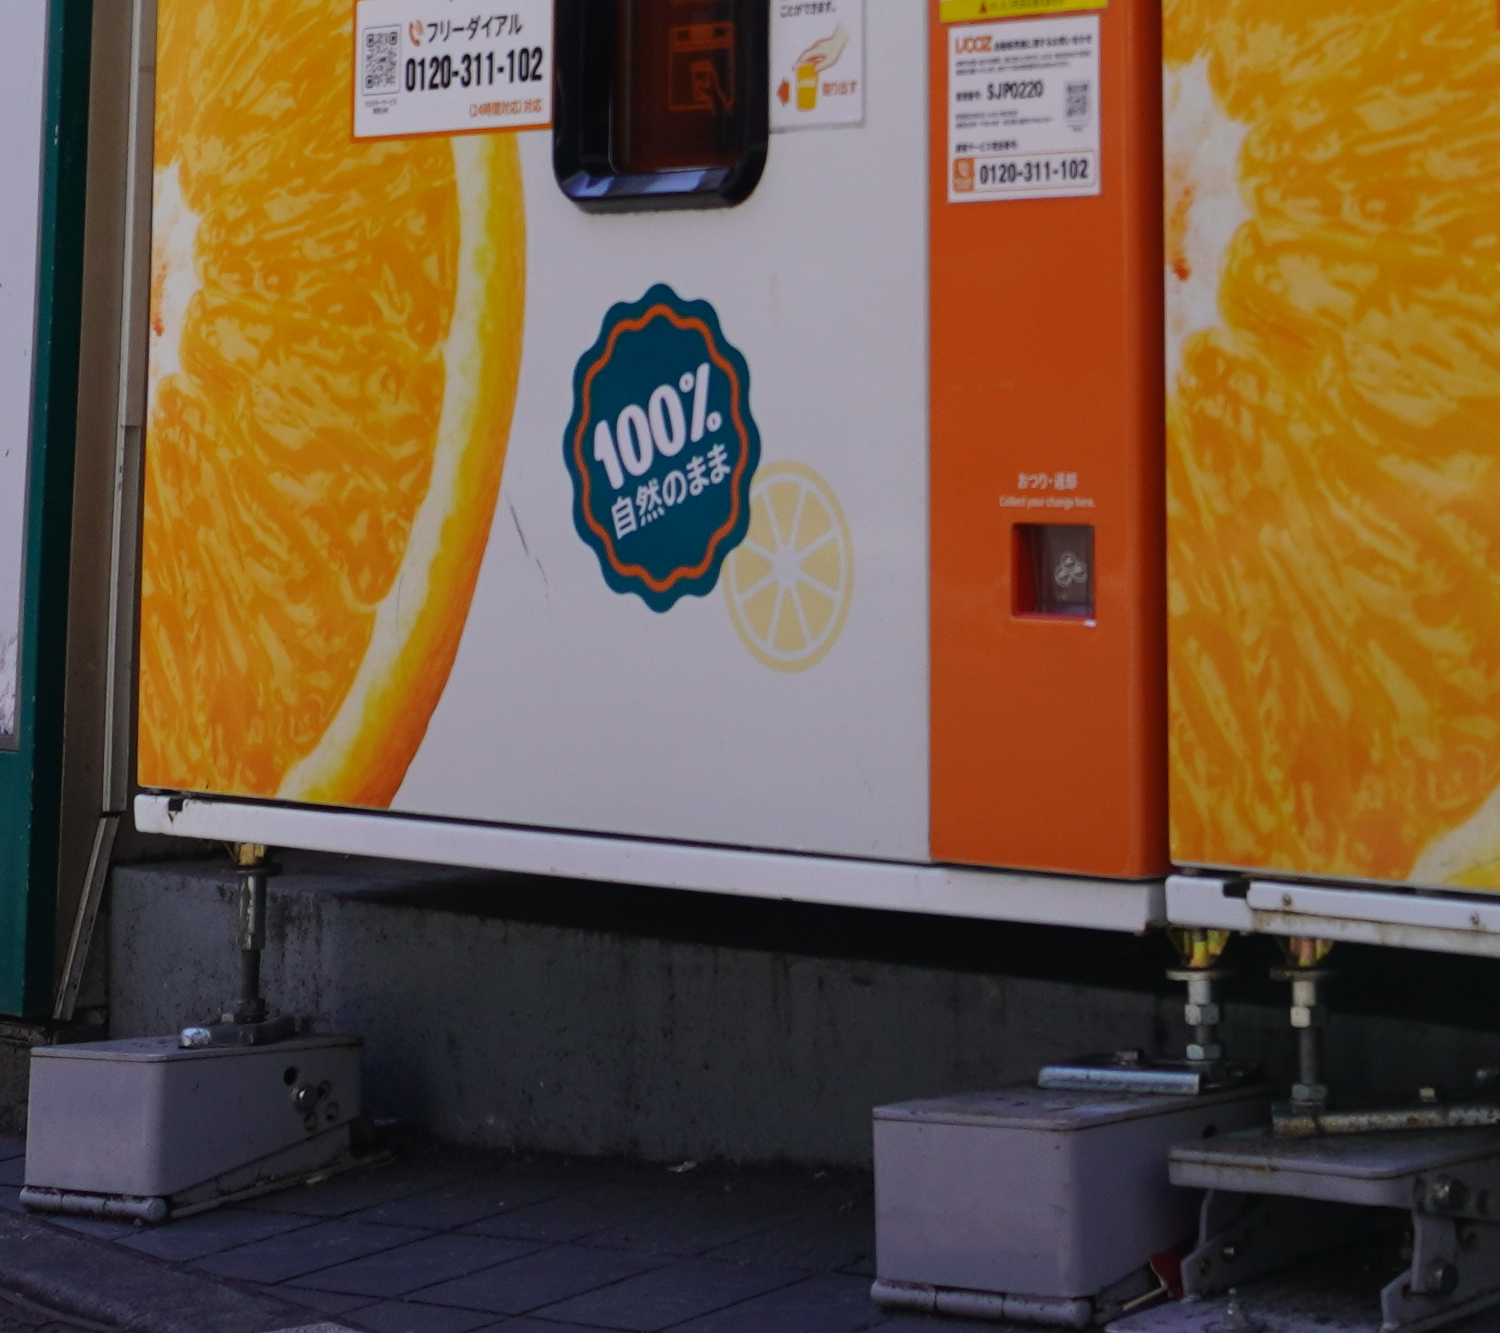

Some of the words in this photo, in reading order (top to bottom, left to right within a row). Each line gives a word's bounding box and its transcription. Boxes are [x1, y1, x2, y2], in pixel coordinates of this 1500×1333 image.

[426, 13, 523, 46] フリーダイアル
[405, 46, 544, 93] 0120-311-102
[986, 80, 1044, 101] SJP0220
[979, 158, 1090, 185] 0120-311-102
[594, 361, 723, 490] 100%
[611, 443, 731, 542] 自然のまま
